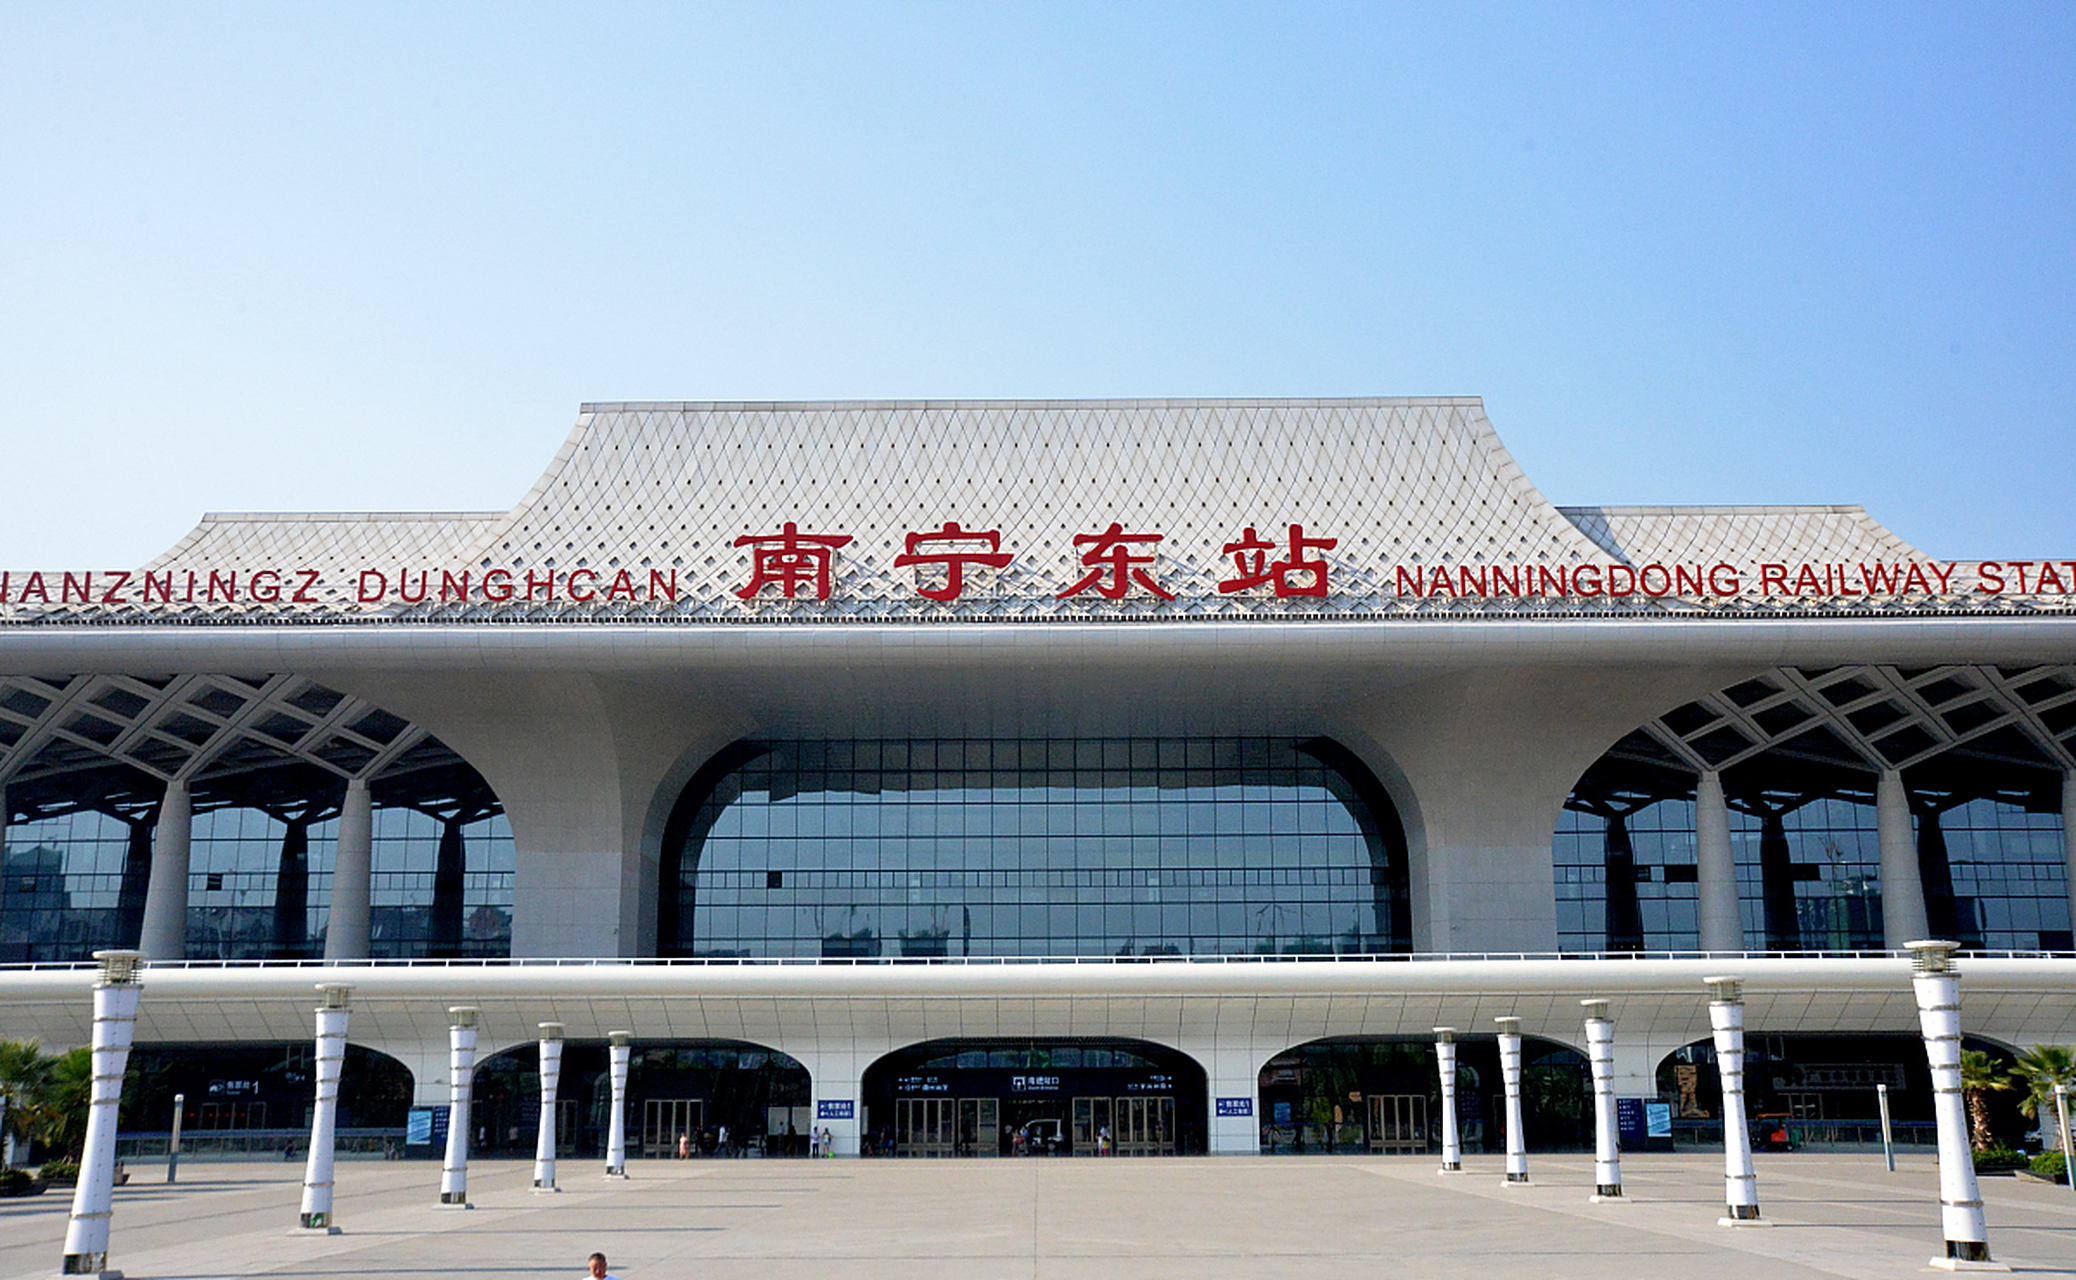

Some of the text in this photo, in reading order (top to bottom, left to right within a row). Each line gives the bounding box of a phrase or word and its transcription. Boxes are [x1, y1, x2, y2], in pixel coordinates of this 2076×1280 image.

[733, 521, 1339, 601] 南宁东站
[357, 568, 677, 604] DUNGHCAN
[1395, 563, 1740, 599] NANNINGDONG
[1760, 562, 1957, 597] RAILWAY
